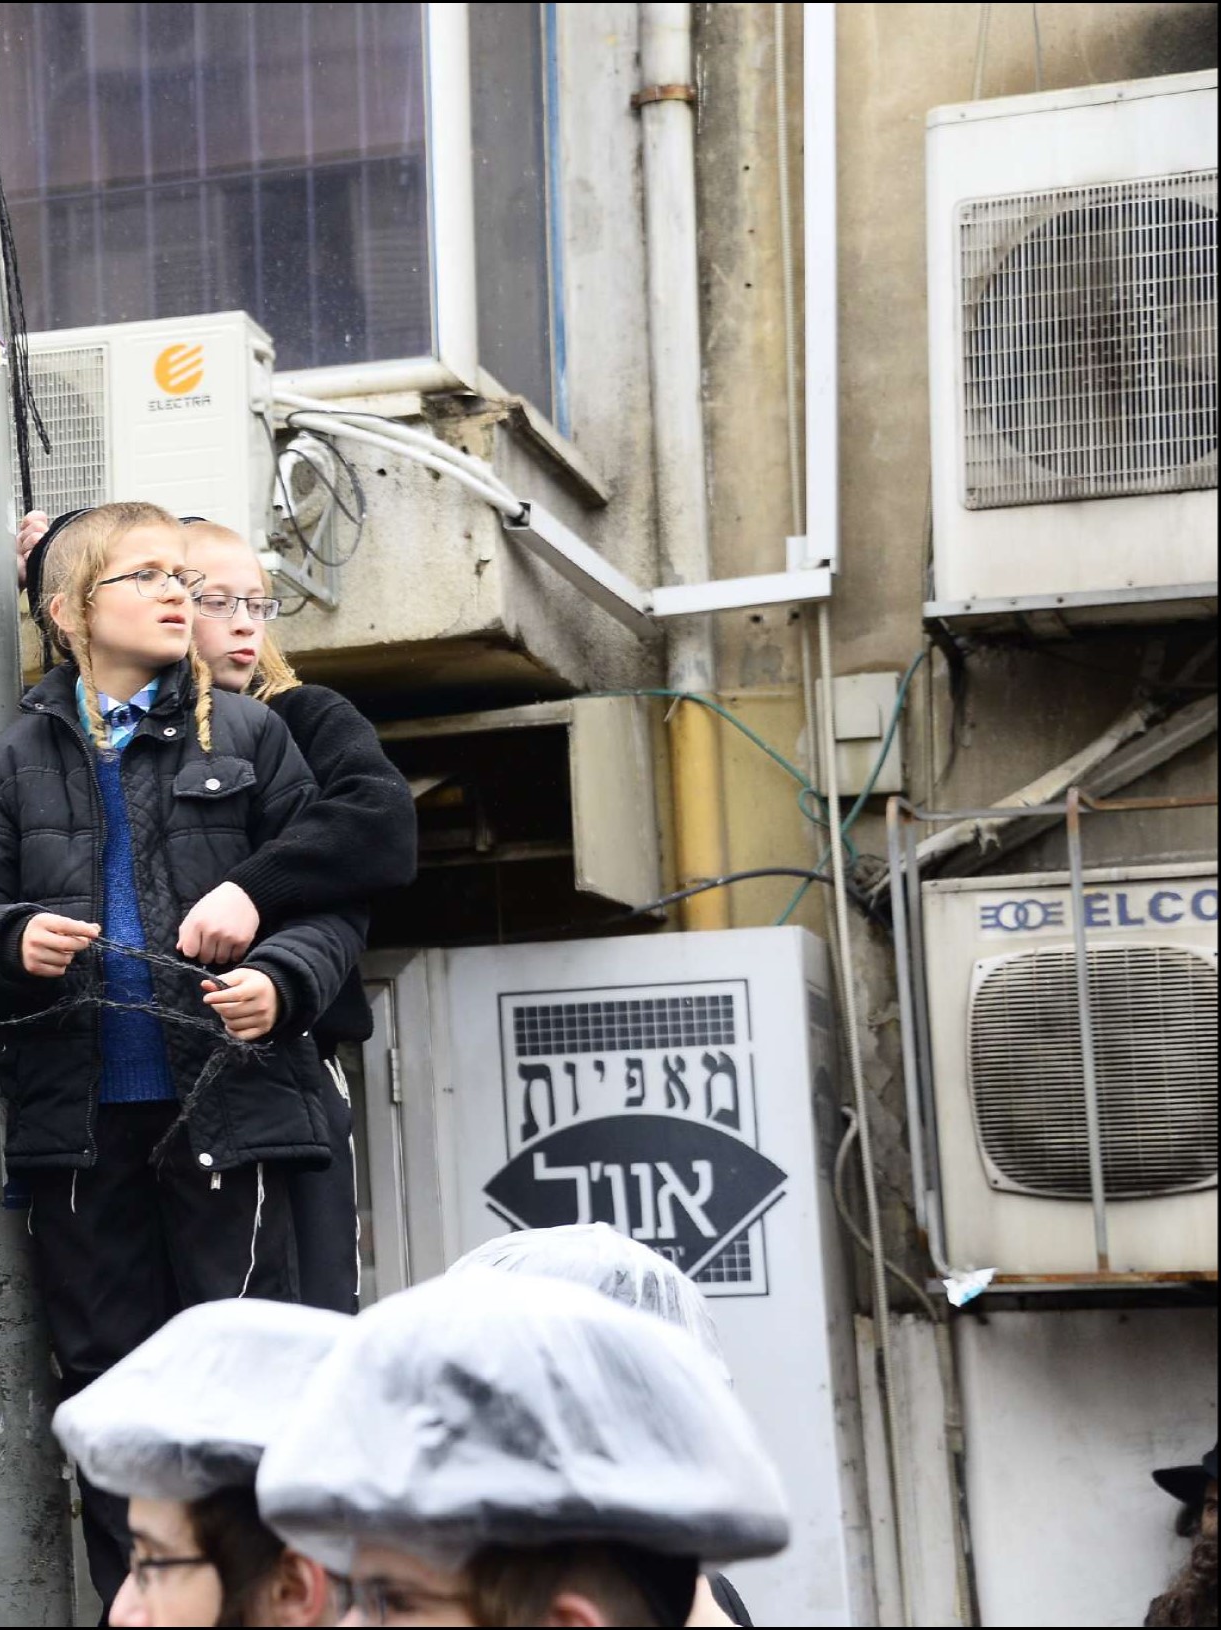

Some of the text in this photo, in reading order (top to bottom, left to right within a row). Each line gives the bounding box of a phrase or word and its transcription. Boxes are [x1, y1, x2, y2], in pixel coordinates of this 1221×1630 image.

[148, 394, 211, 411] ELECTRA
[1083, 888, 1217, 927] ELCO
[517, 1050, 742, 1143] מאפיות
